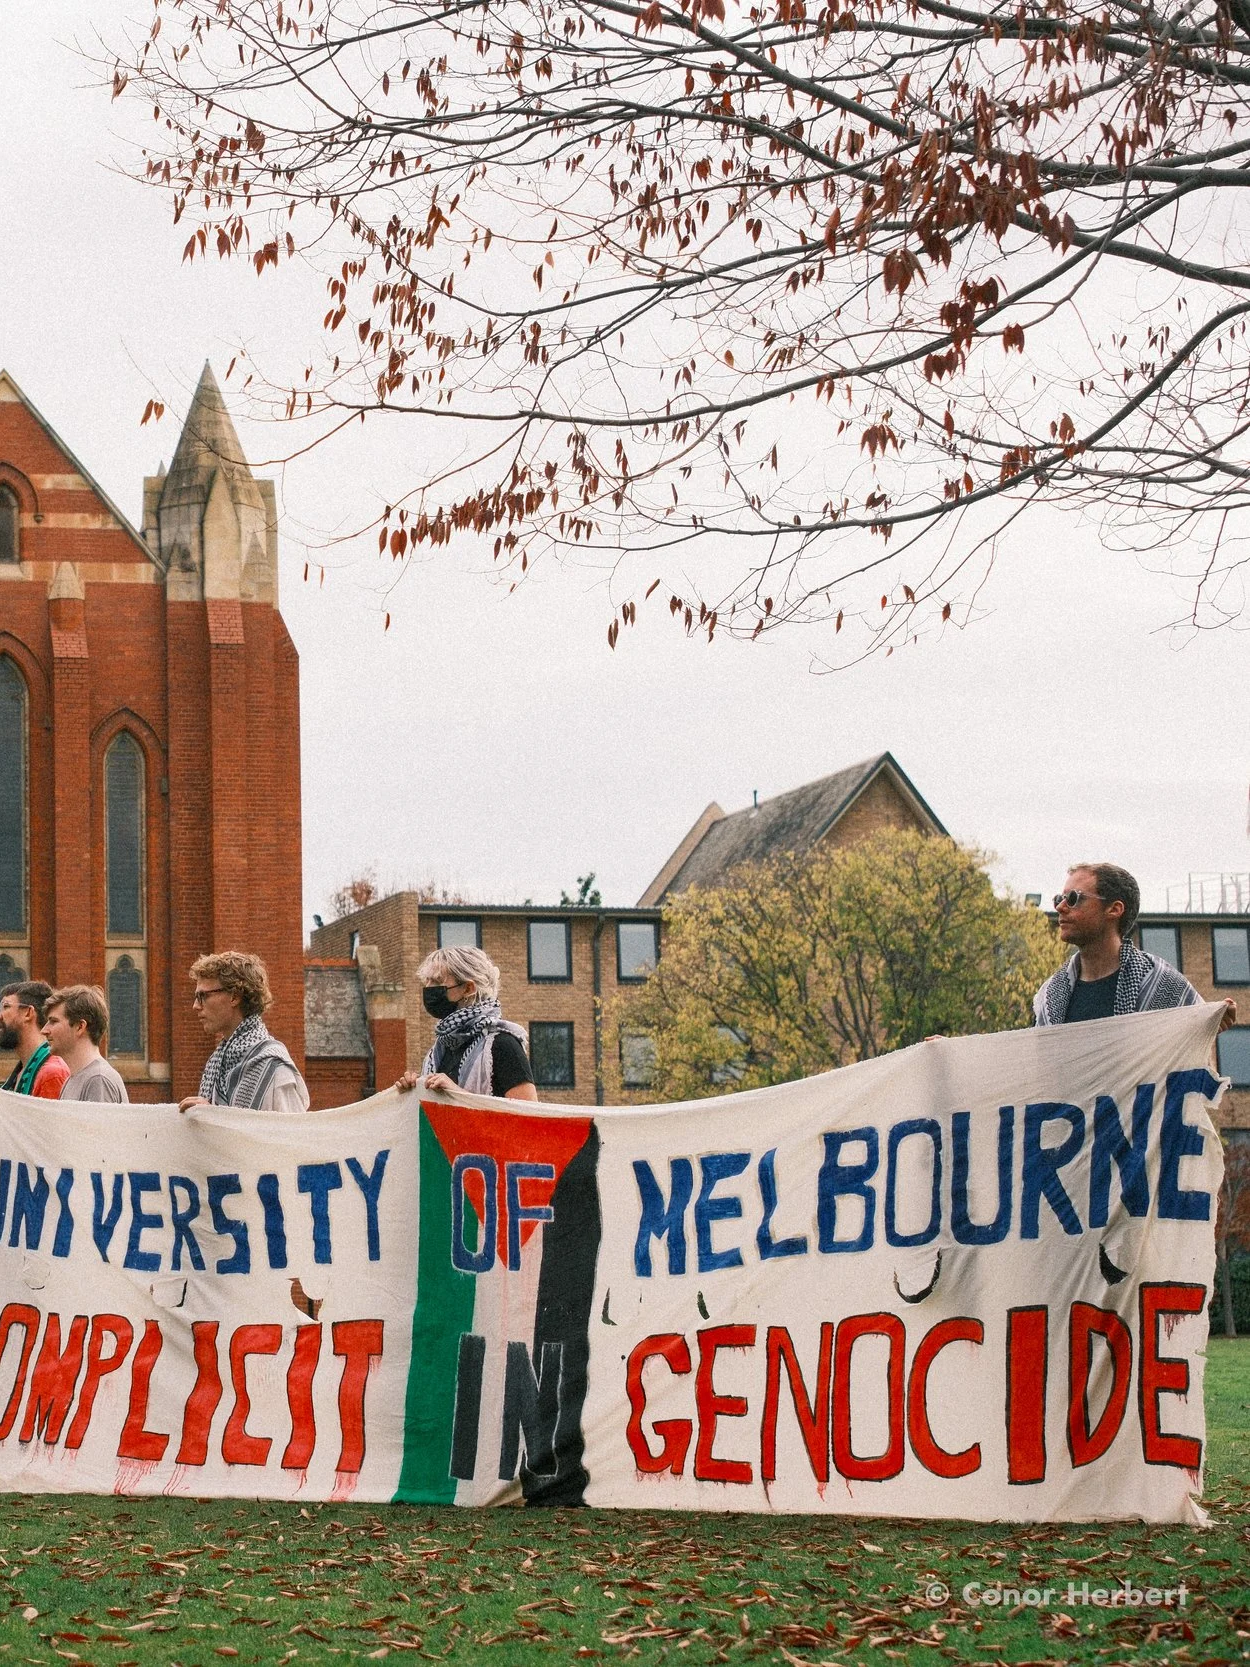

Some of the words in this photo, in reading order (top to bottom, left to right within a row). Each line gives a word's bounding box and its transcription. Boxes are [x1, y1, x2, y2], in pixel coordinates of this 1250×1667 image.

[452, 1152, 555, 1275] OF
[633, 1068, 1224, 1278] MELBOURNE
[449, 1331, 564, 1482] IN
[626, 1281, 1207, 1486] GENOCIDE
